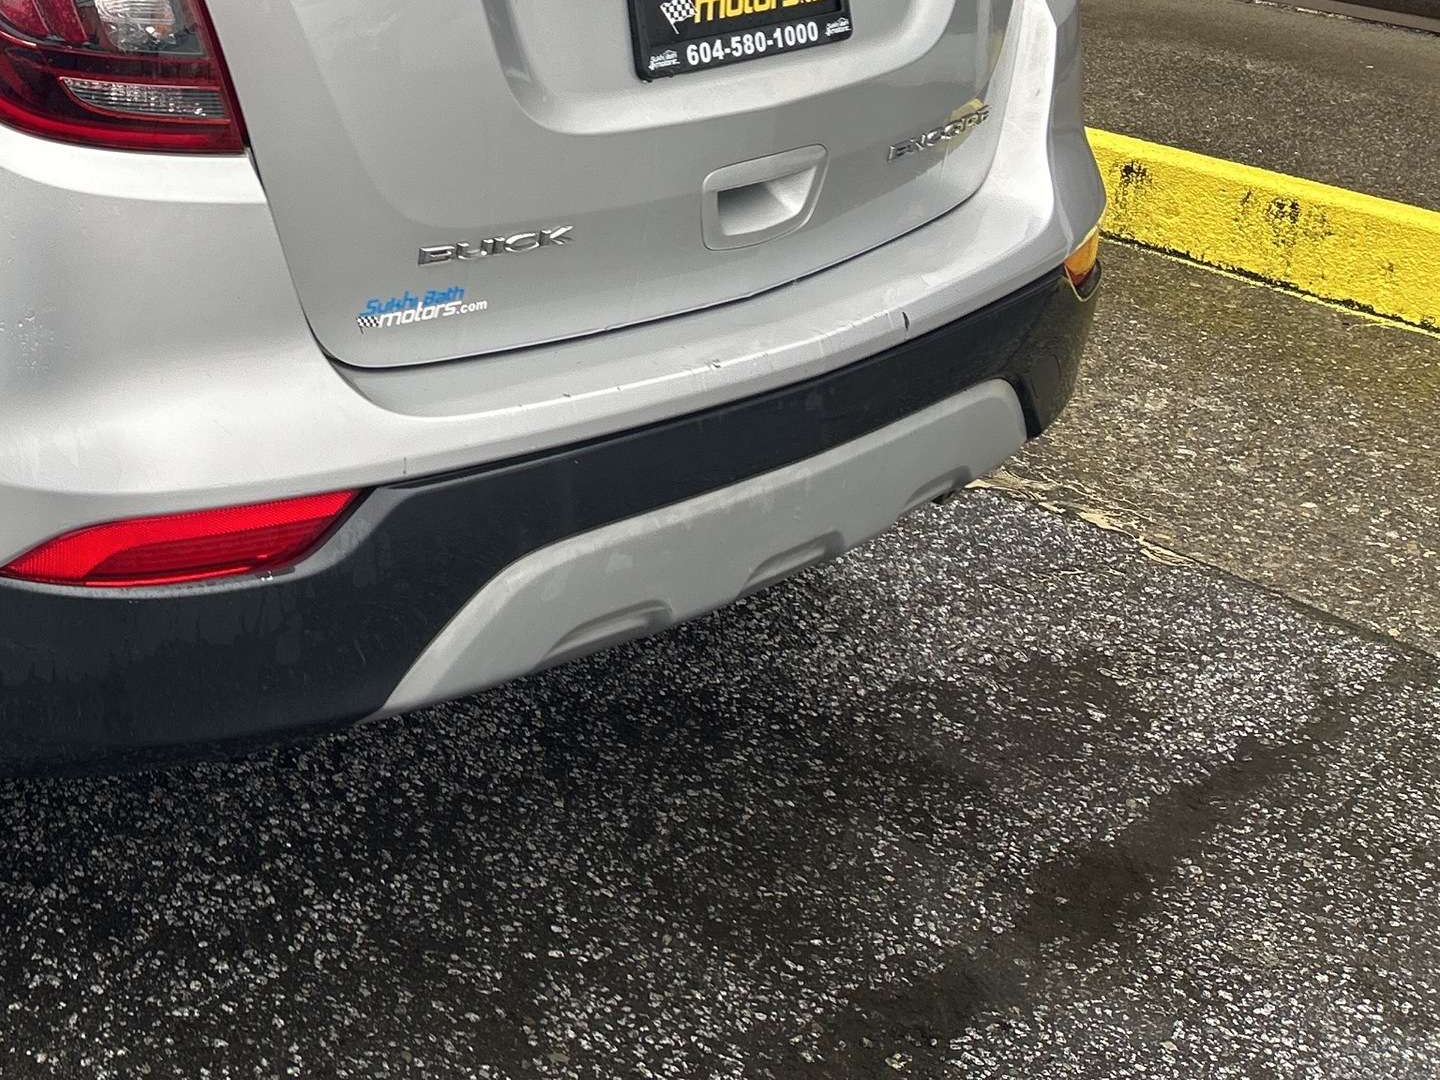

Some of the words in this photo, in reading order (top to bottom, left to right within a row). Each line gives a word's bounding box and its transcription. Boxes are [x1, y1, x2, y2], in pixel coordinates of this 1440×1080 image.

[686, 21, 819, 66] 604-580-1000
[417, 225, 574, 267] BUICK
[359, 290, 419, 317] Sukhi
[421, 285, 465, 308] Bath
